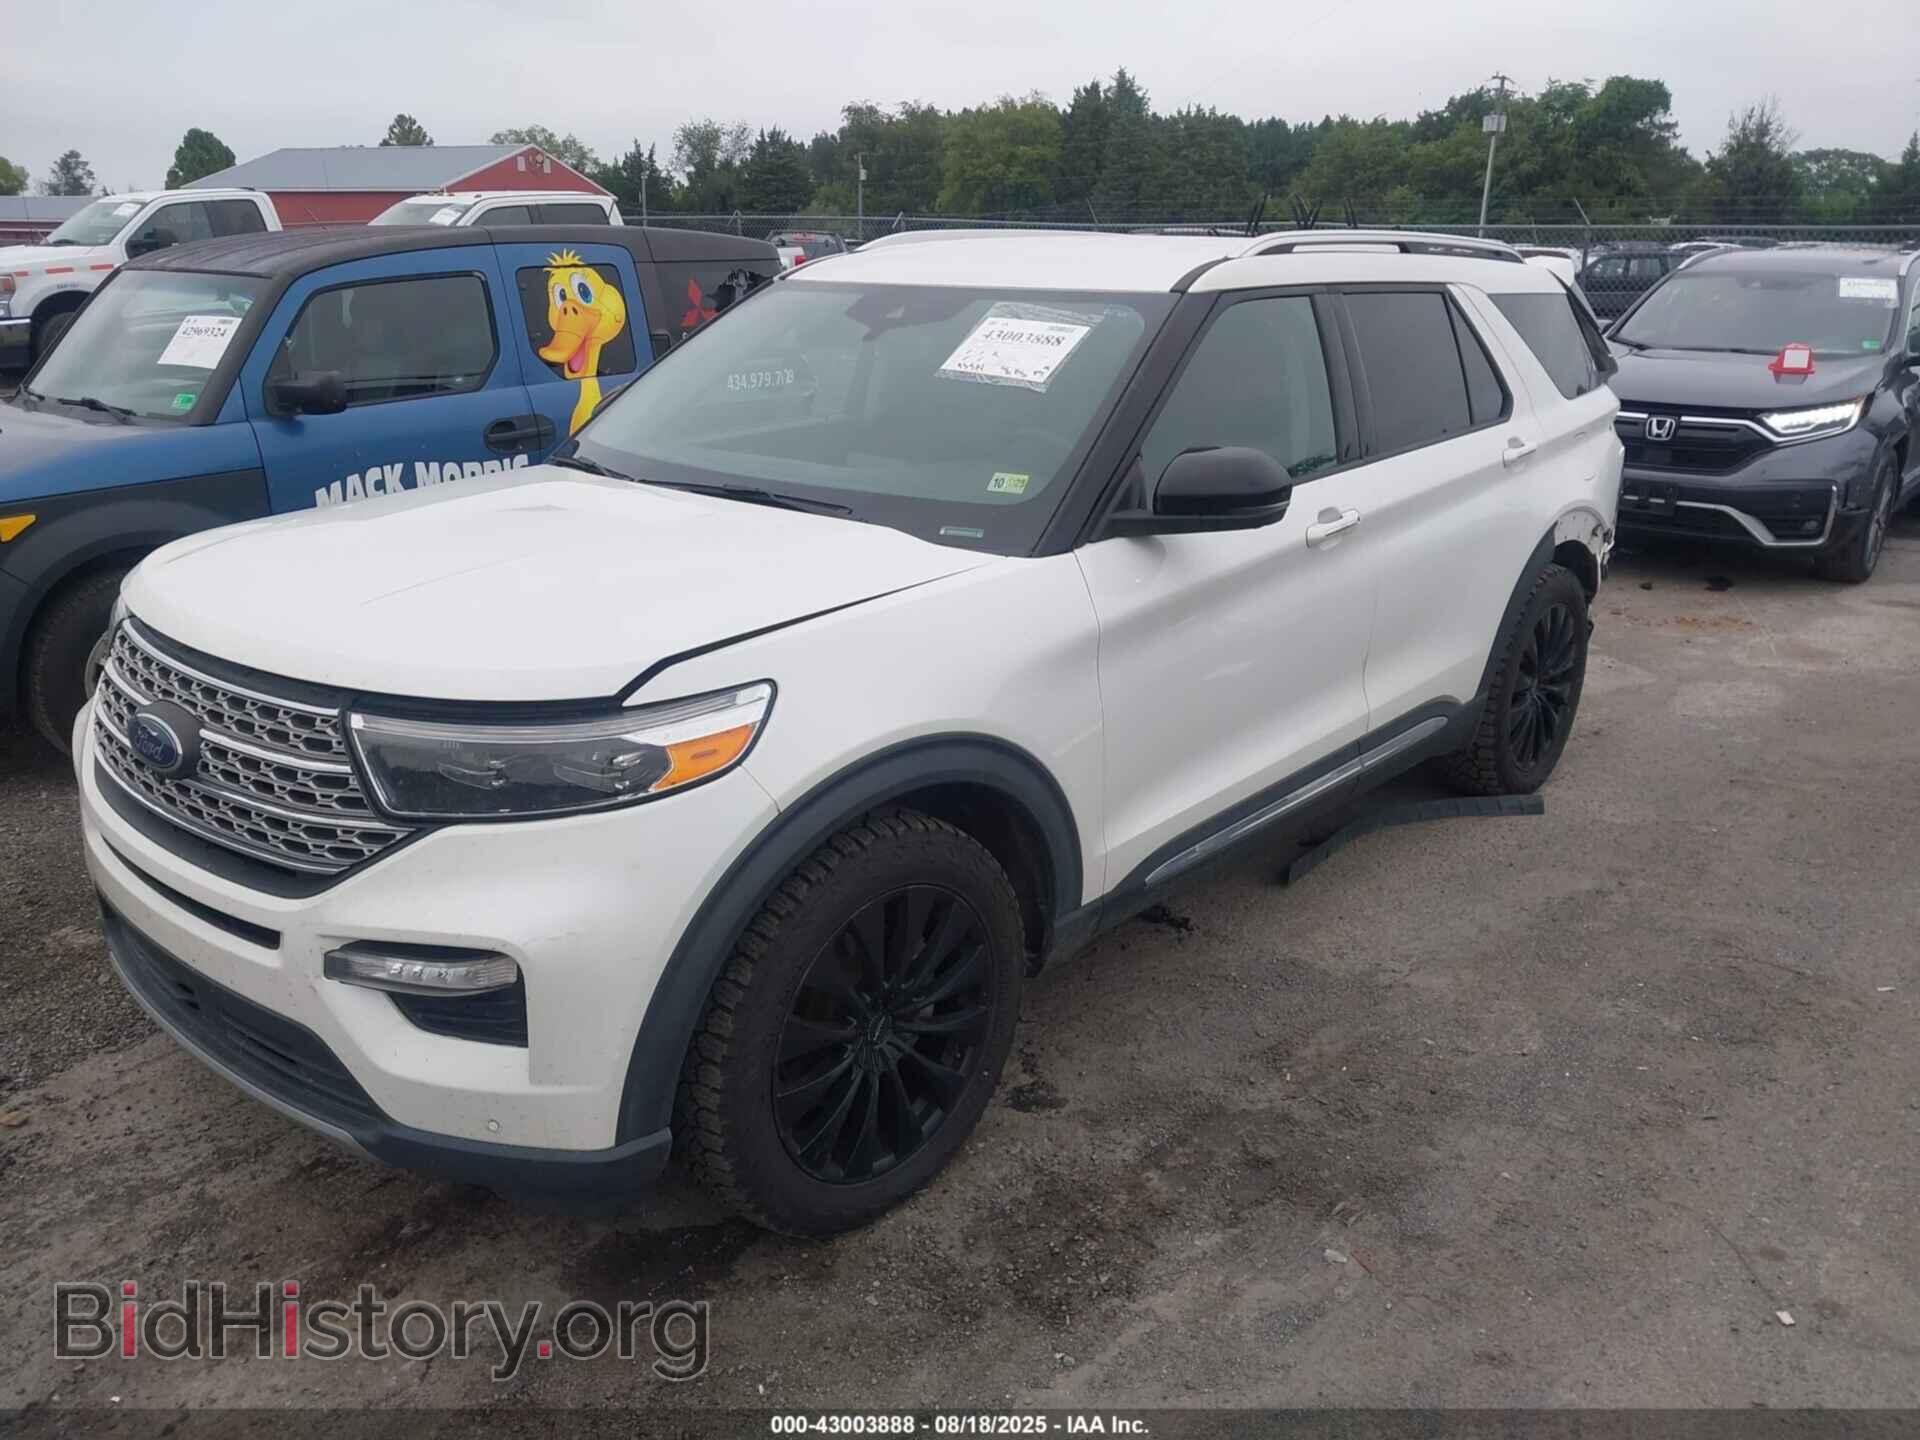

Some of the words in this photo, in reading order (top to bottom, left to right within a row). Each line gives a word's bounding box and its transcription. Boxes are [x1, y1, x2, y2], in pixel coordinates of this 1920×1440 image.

[182, 326, 227, 338] 42969324
[983, 329, 1066, 347] 43003888
[315, 462, 404, 509] MACK
